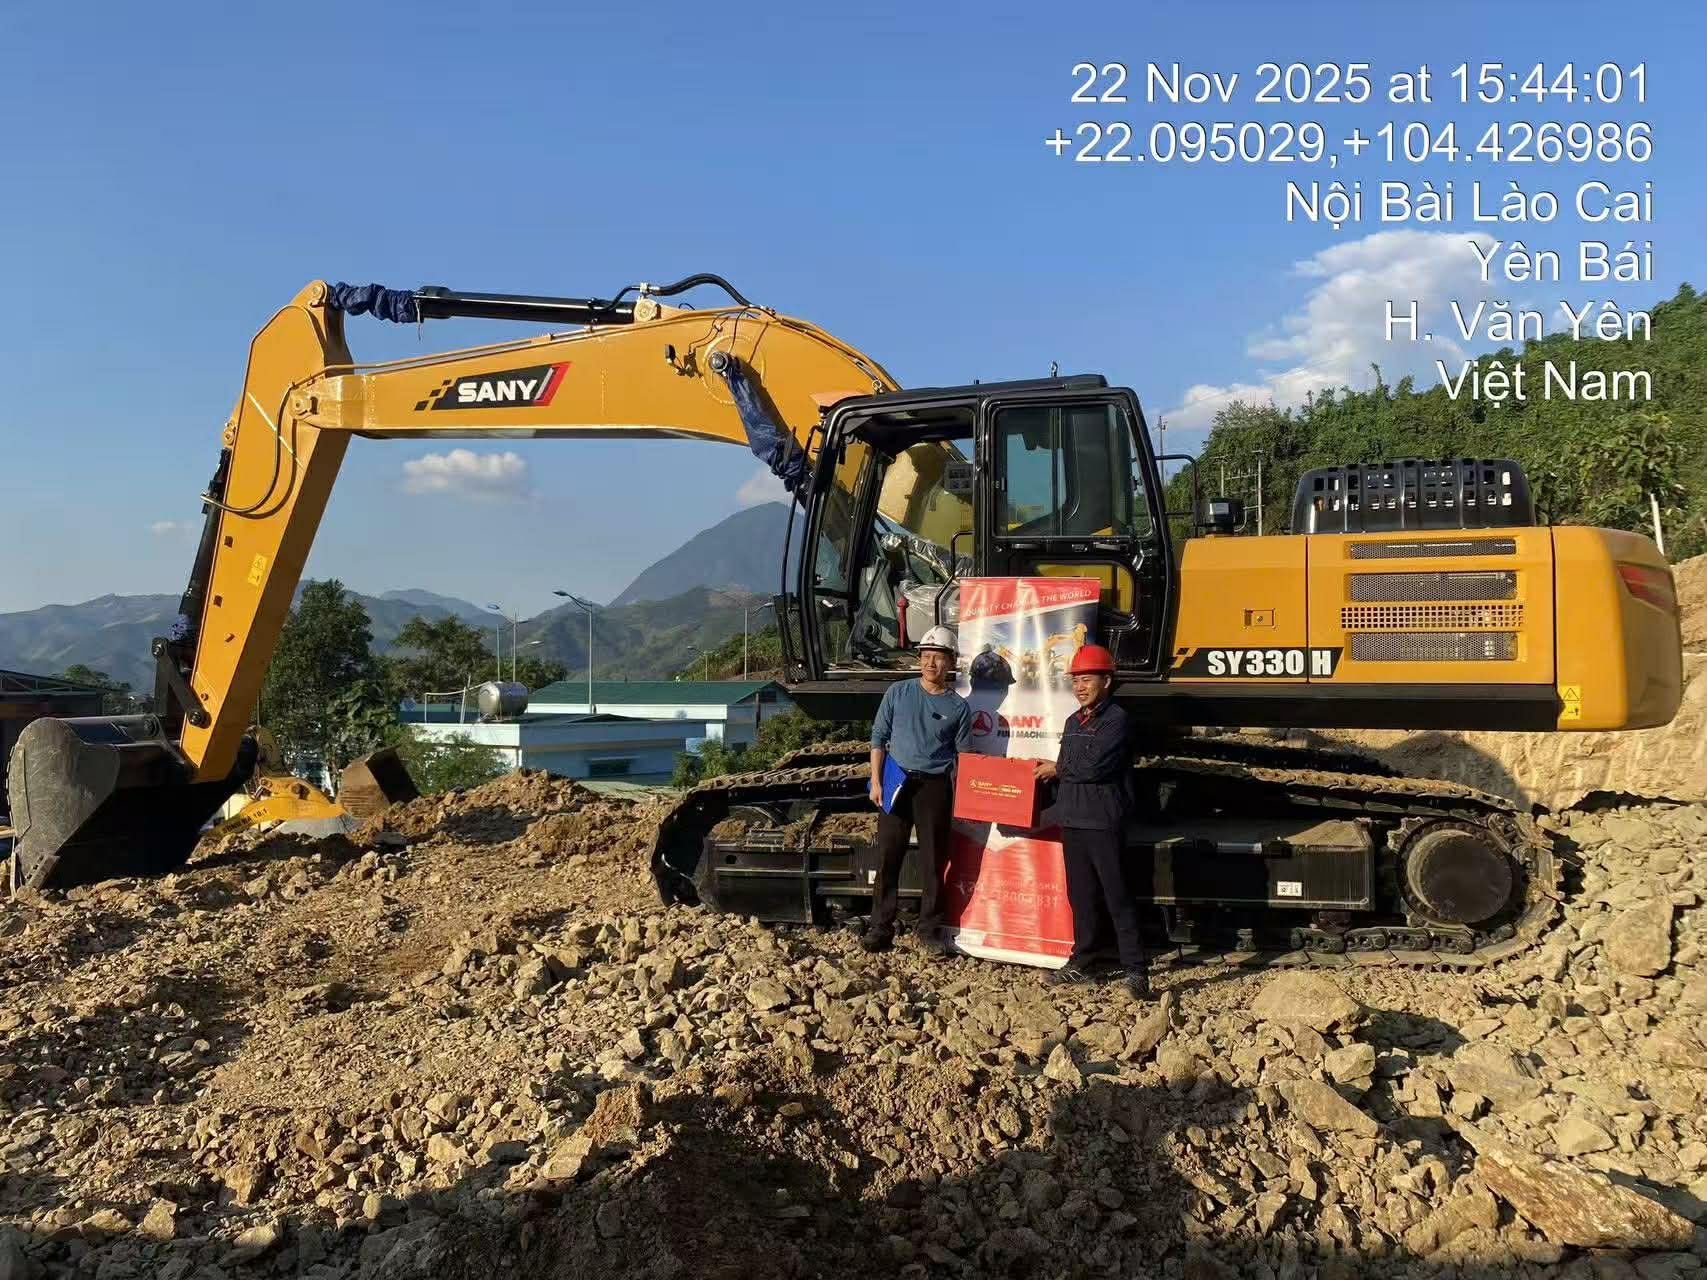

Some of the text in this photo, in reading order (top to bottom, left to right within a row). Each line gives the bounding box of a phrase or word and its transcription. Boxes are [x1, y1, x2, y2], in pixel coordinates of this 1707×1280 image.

[458, 379, 537, 403] SANY
[1041, 595, 1057, 603] THE
[1060, 590, 1092, 600] WORLD
[1207, 650, 1332, 675] SY330 H
